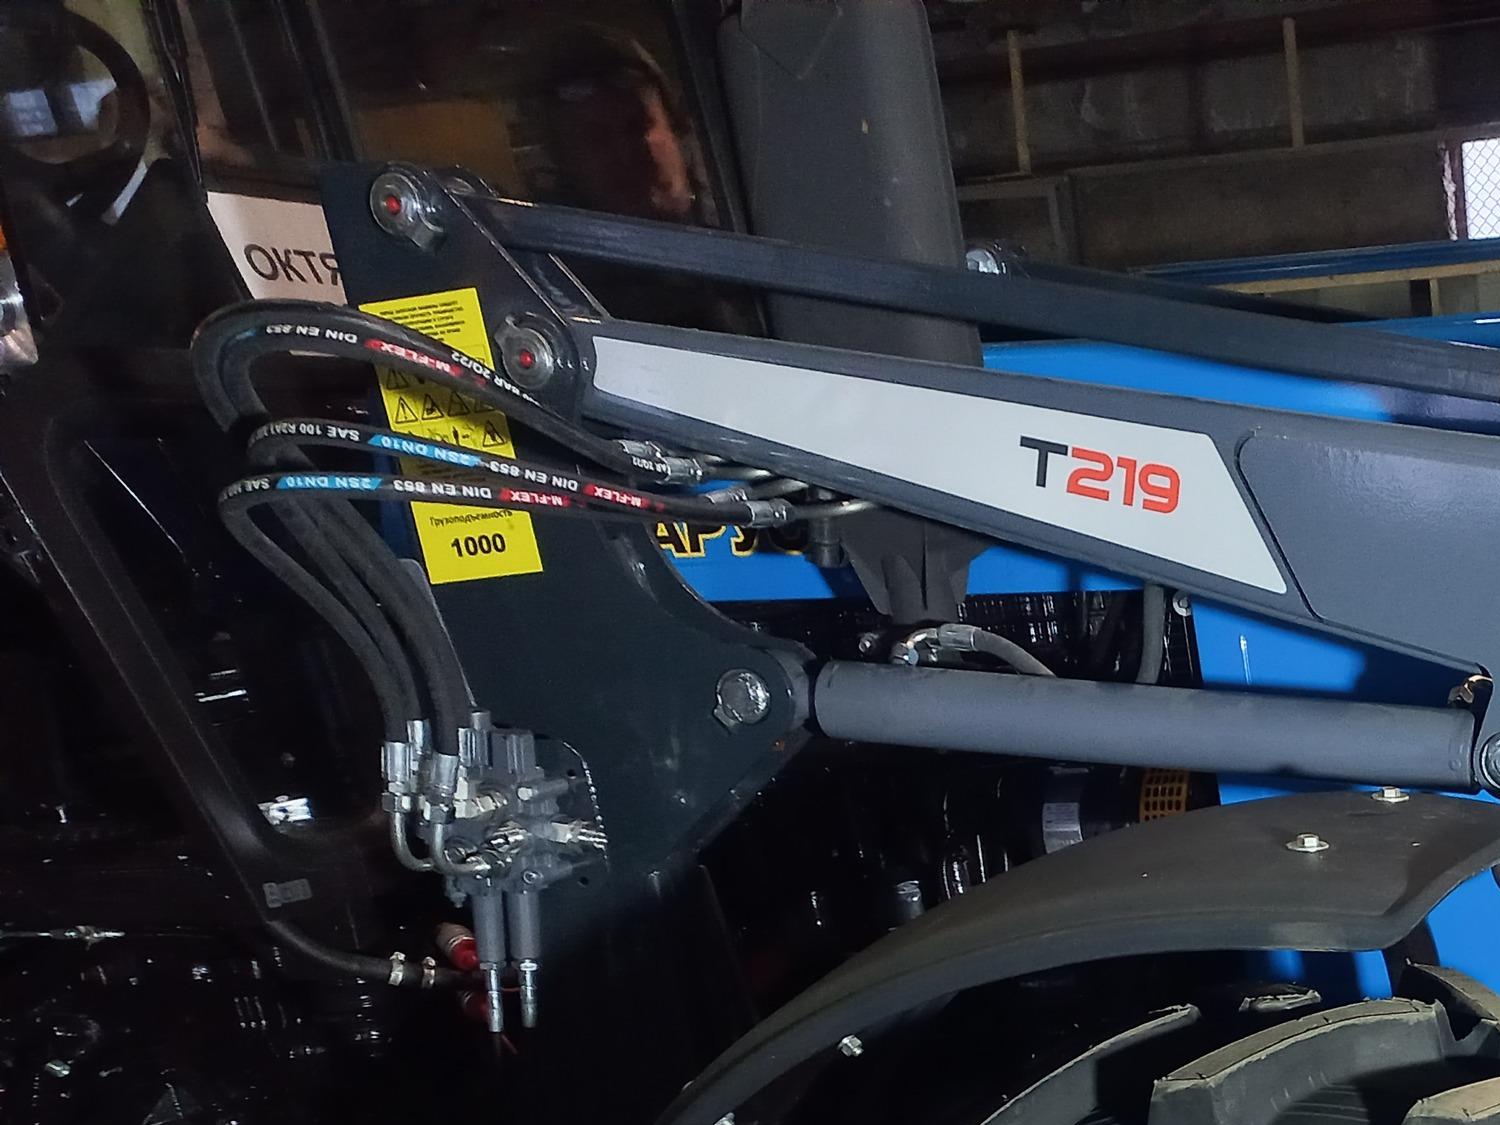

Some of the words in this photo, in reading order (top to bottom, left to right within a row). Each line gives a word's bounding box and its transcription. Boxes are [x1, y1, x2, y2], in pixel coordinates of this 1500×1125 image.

[296, 325, 320, 337] EN
[325, 329, 358, 343] DIN
[380, 342, 451, 374] M-FLEX
[299, 423, 322, 435] 100
[326, 425, 360, 441] SAE
[381, 435, 428, 455] DN10
[434, 445, 474, 467] 2SN
[490, 460, 522, 477] 853
[524, 468, 548, 484] EN
[1019, 435, 1181, 514] T219
[286, 476, 328, 489] DN10
[335, 477, 372, 490] 2SN
[432, 483, 456, 496] EN
[551, 475, 578, 491] DIN
[460, 484, 492, 499] DIN
[510, 490, 563, 507] M-FLEX
[593, 484, 643, 508] M-FLEX
[450, 533, 506, 557] 1000
